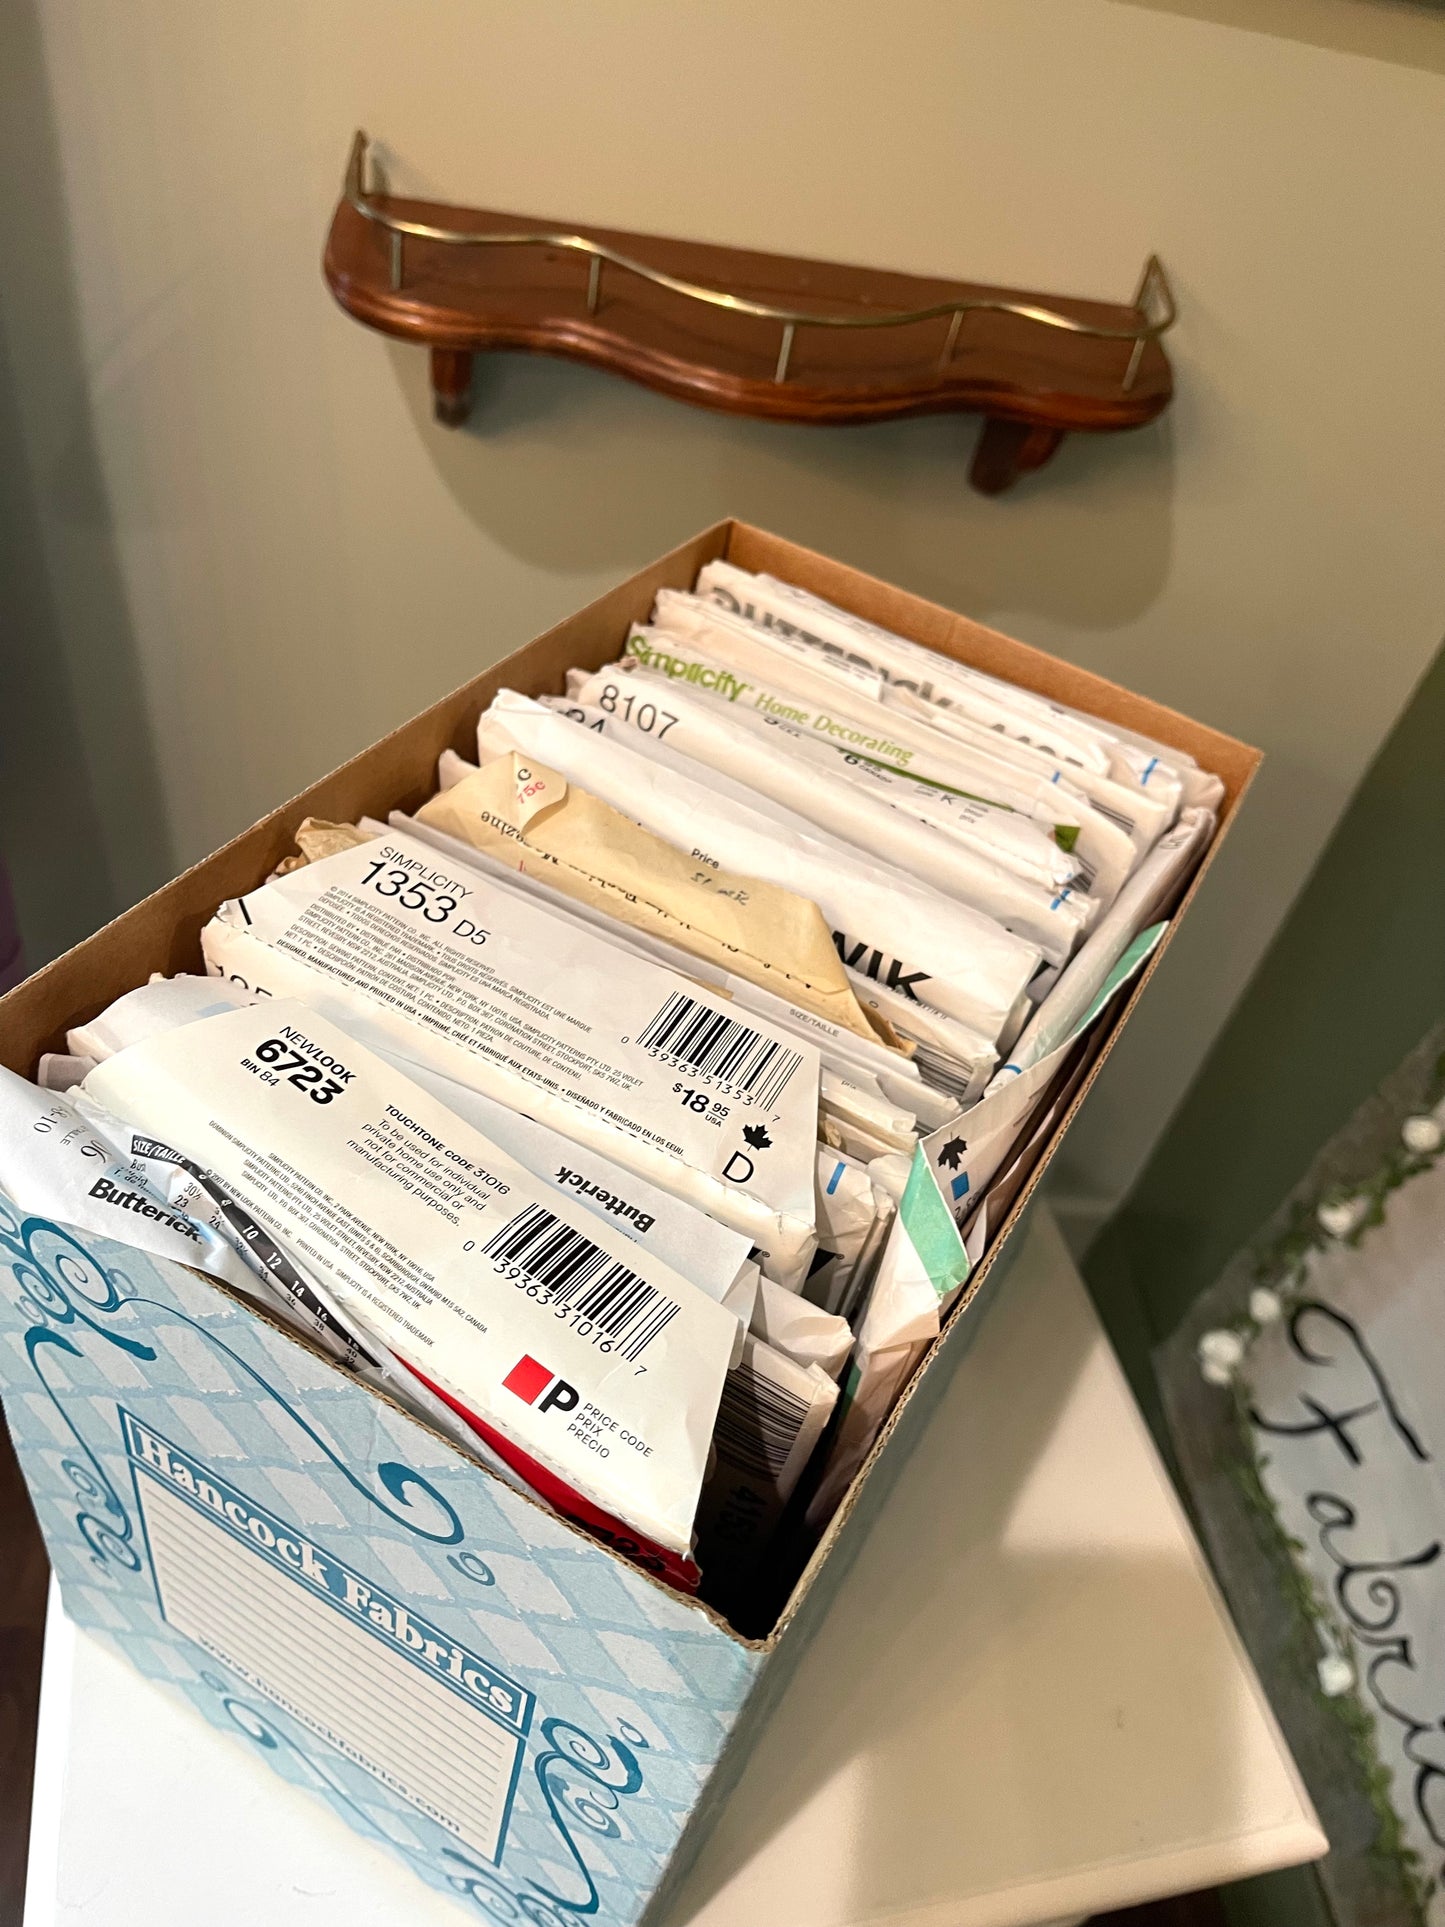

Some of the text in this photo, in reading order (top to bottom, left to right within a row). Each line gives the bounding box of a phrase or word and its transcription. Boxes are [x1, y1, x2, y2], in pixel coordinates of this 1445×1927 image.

[599, 684, 680, 740] 8107
[628, 635, 746, 702] Simplicity
[754, 692, 809, 725] Home
[812, 715, 916, 768] Decorating
[516, 767, 533, 782] C
[380, 846, 473, 898] SIMPLICITY
[691, 848, 720, 870] Price
[361, 861, 491, 945] 1353 D5
[304, 908, 336, 928] SIMPLICITY
[334, 925, 361, 942] PATTERN
[383, 951, 397, 961] 261
[395, 957, 425, 975] MADISON
[446, 983, 463, 994] NEW
[478, 999, 489, 1008] NY
[522, 1023, 557, 1044] SIMPLICITY
[555, 1040, 587, 1060] PATTERNS
[611, 1069, 622, 1077] 25
[621, 1073, 644, 1087] VIOLET
[832, 930, 932, 1003] WIK
[279, 1026, 356, 1084] NEWLOOK
[307, 955, 356, 982] MANUFACTURED
[354, 979, 370, 989] AND
[368, 985, 396, 1003] PRINTED
[395, 1000, 404, 1008] IN
[403, 1004, 417, 1015] USA
[467, 1038, 478, 1046] ET
[507, 1059, 523, 1070] AUX
[604, 1109, 642, 1133] FABRICADO
[641, 1128, 652, 1138] EN
[651, 1134, 666, 1145] LOS
[502, 1034, 514, 1043] DE
[541, 1055, 553, 1064] DE
[789, 1008, 840, 1037] SIZE/TAILLE
[240, 1058, 280, 1086] BIN 84
[256, 1039, 344, 1104] 6723
[620, 1036, 781, 1123] 0 39363 51353 7
[385, 1104, 511, 1195] TOUCHTONE CODE 31016
[704, 1114, 722, 1127] USA
[346, 1140, 460, 1226] manufacturing purposes.
[361, 1123, 487, 1211] private home use only and
[364, 1138, 465, 1210] not for commercial or
[378, 1118, 491, 1200] To be used for individual
[722, 1151, 754, 1183] D
[173, 1194, 189, 1208] 23
[267, 1152, 296, 1174] SIMPLICITY
[293, 1171, 316, 1190] PATTERN
[337, 1206, 353, 1219] PARK
[371, 1231, 386, 1244] NEW
[397, 1253, 408, 1261] NY
[422, 1271, 435, 1282] USA
[554, 1166, 656, 1234] Butterick
[242, 1225, 259, 1240] 10
[266, 1252, 282, 1270] 12
[291, 1280, 306, 1298] 14
[316, 1306, 328, 1322] 16
[462, 1240, 648, 1376] 0 39363 31016 7
[539, 1380, 653, 1457] P PRICE CODE
[566, 1423, 610, 1458] PRECIO
[574, 1412, 603, 1437] PRIX
[137, 1427, 513, 1714] Hancock Fabrics
[199, 1638, 461, 1833] www.hancockfabrics.com
